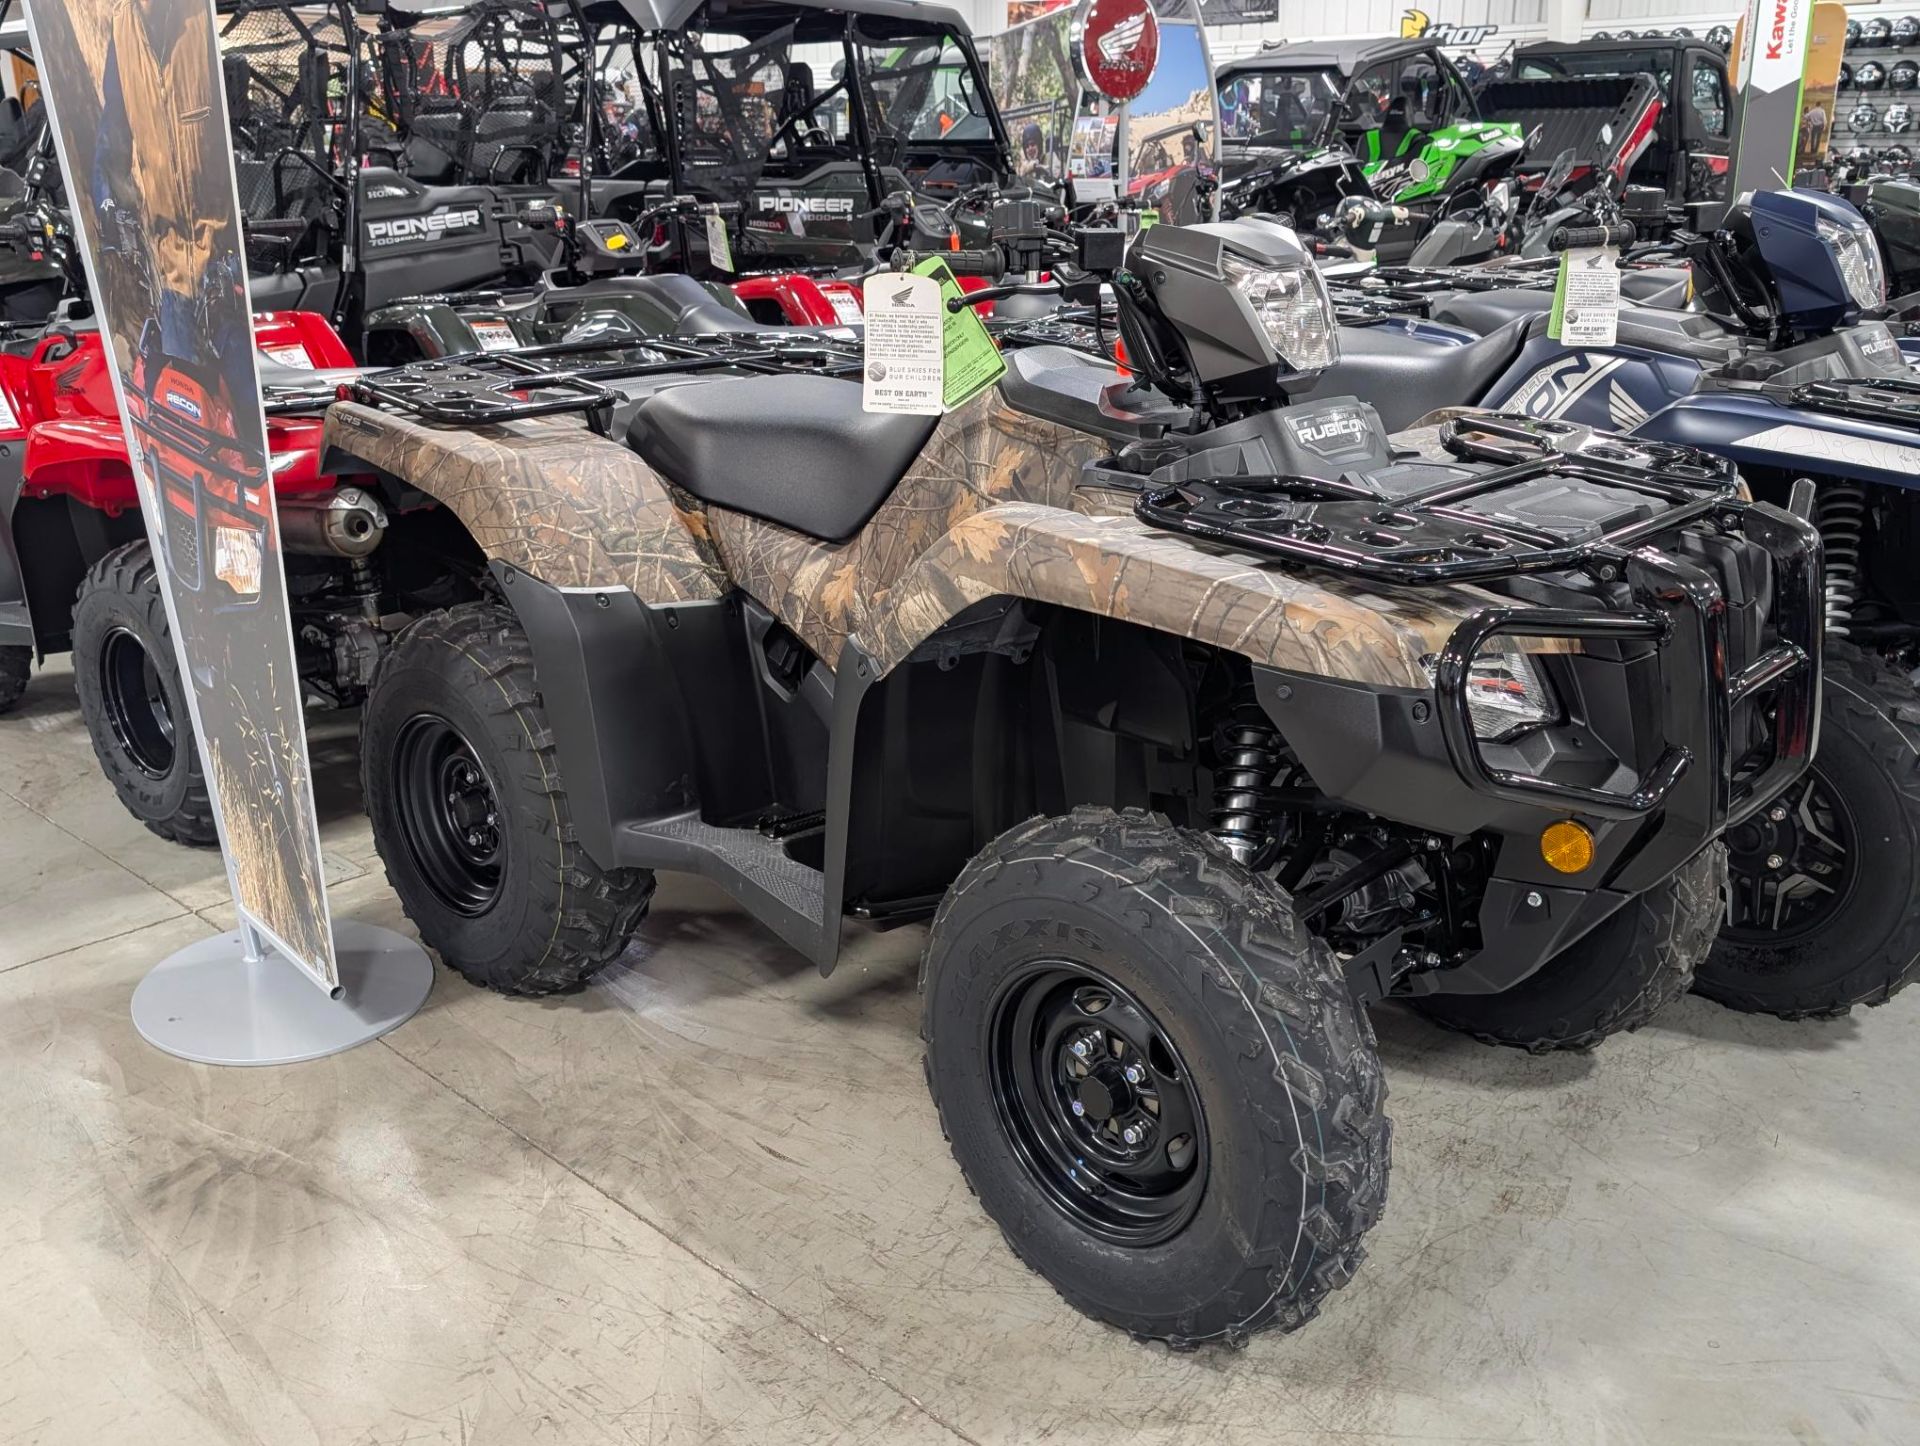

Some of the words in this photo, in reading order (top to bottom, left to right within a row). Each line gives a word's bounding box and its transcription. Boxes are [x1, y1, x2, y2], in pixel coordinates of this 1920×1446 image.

[1791, 0, 1799, 18] Goo
[1422, 23, 1498, 45] thor
[1765, 0, 1788, 60] Kaw
[1788, 21, 1797, 36] the
[1786, 39, 1794, 54] Let
[759, 196, 854, 213] PIONEER
[367, 209, 480, 239] PIONEER
[750, 219, 782, 230] HONDA
[889, 366, 906, 374] BLUE
[905, 374, 942, 382] CHILDREN
[170, 376, 195, 395] HONDA
[874, 389, 892, 397] BEST
[894, 389, 904, 398] ON
[166, 392, 202, 419] RECON
[340, 412, 362, 427] IRS
[1296, 418, 1368, 444] RUBICON
[949, 917, 1107, 1017] MAXXIS
